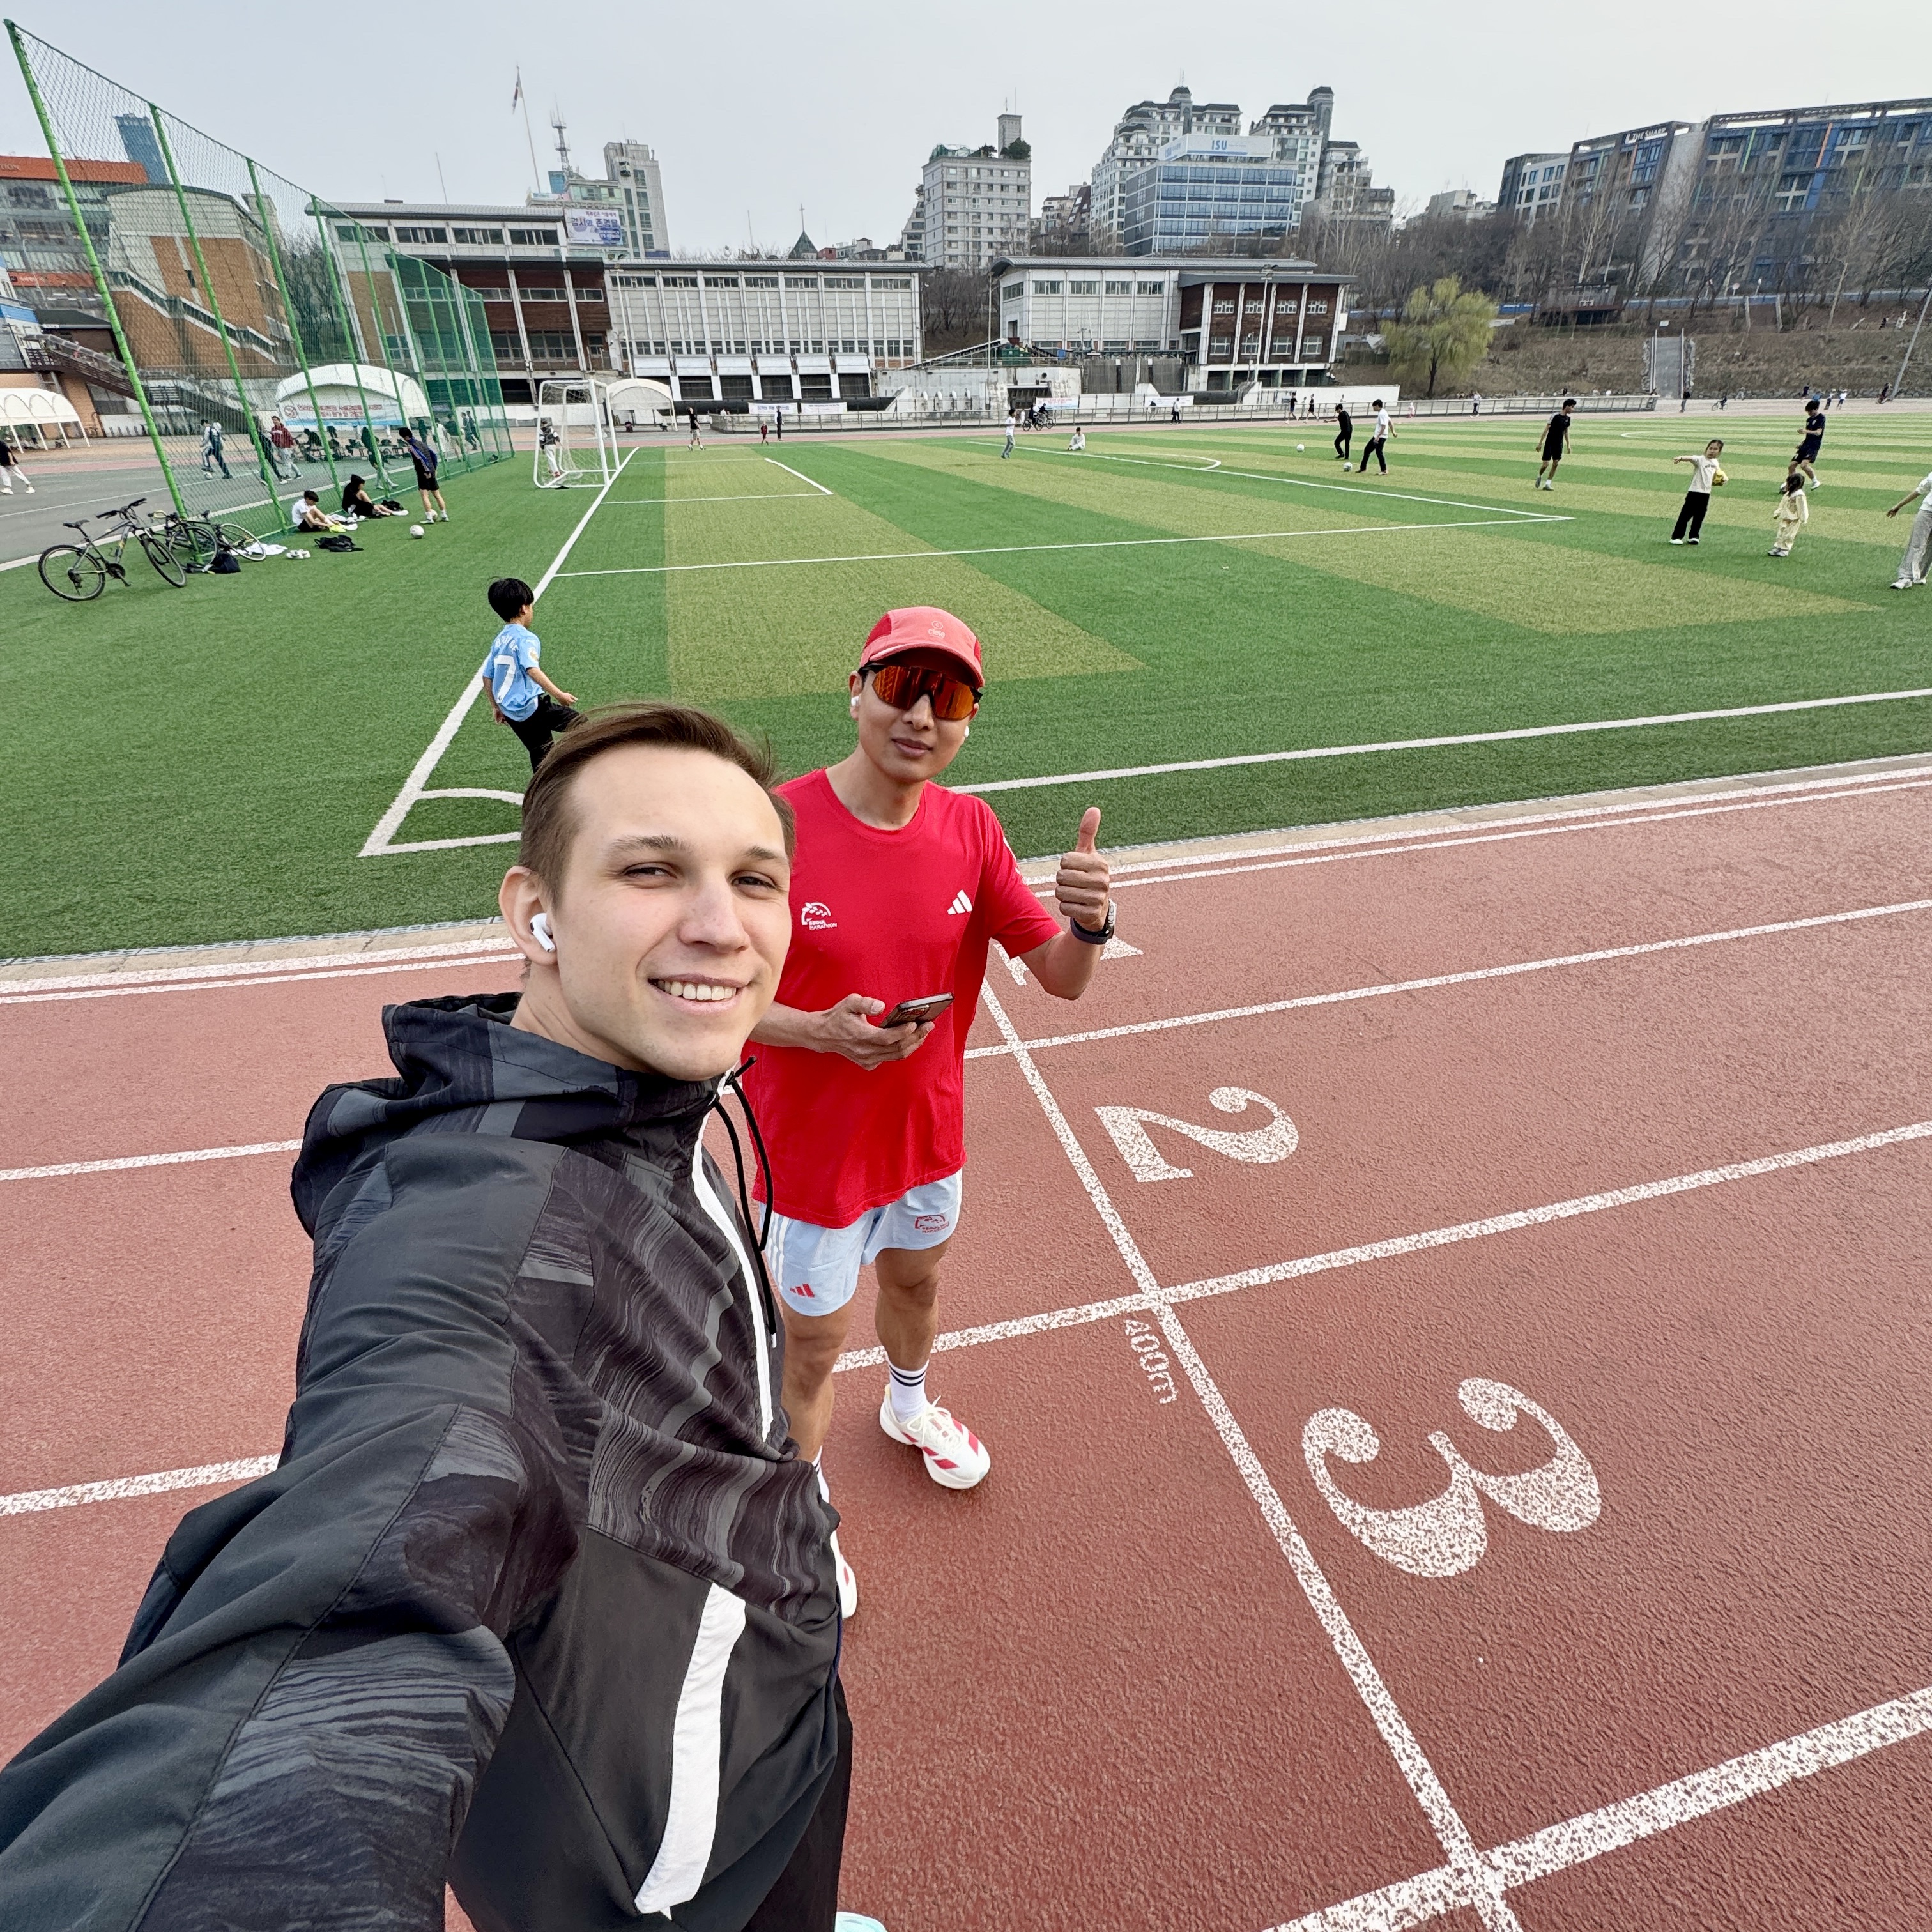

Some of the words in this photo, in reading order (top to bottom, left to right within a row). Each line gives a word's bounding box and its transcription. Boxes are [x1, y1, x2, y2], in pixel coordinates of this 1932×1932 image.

[1211, 140, 1227, 150] ISU
[570, 217, 593, 227] 감사와
[595, 218, 618, 228] 존경을
[809, 922, 838, 930] MARATHON
[1093, 1086, 1300, 1183] 2
[1123, 1319, 1179, 1404] 400m
[1301, 1377, 1602, 1577] 3
